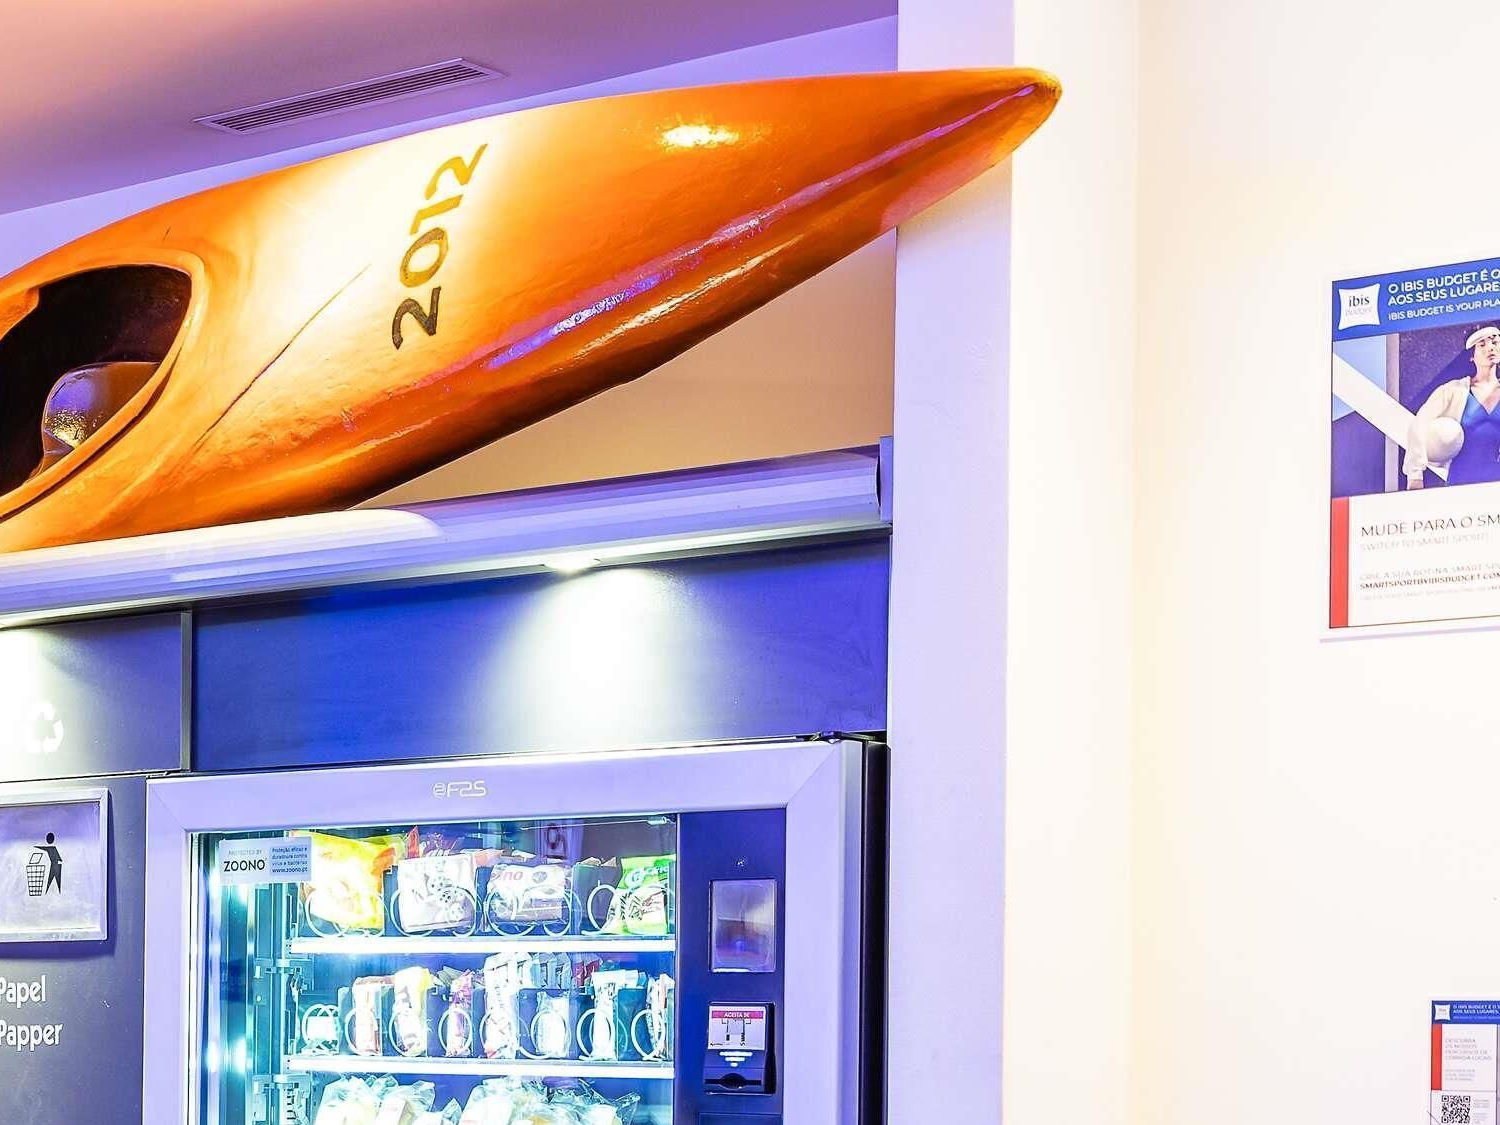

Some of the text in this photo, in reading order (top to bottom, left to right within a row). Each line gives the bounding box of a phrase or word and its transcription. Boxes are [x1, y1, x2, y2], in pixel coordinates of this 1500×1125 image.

[392, 143, 488, 350] 2012
[1388, 283, 1399, 294] O
[1401, 280, 1424, 293] IBIS
[1426, 272, 1479, 289] BUDGET
[1480, 269, 1489, 282] É
[1349, 294, 1371, 307] ibis
[1388, 294, 1414, 306] AOS
[1416, 289, 1448, 303] SEUS
[1388, 309, 1406, 321] IBIS
[1407, 305, 1444, 318] BUDGET
[1446, 303, 1454, 313] IS
[1455, 300, 1481, 312] YOUR
[1361, 522, 1408, 537] MUDE
[1413, 518, 1456, 533] PARA
[1460, 516, 1473, 529] O
[223, 859, 266, 873] ZOONO
